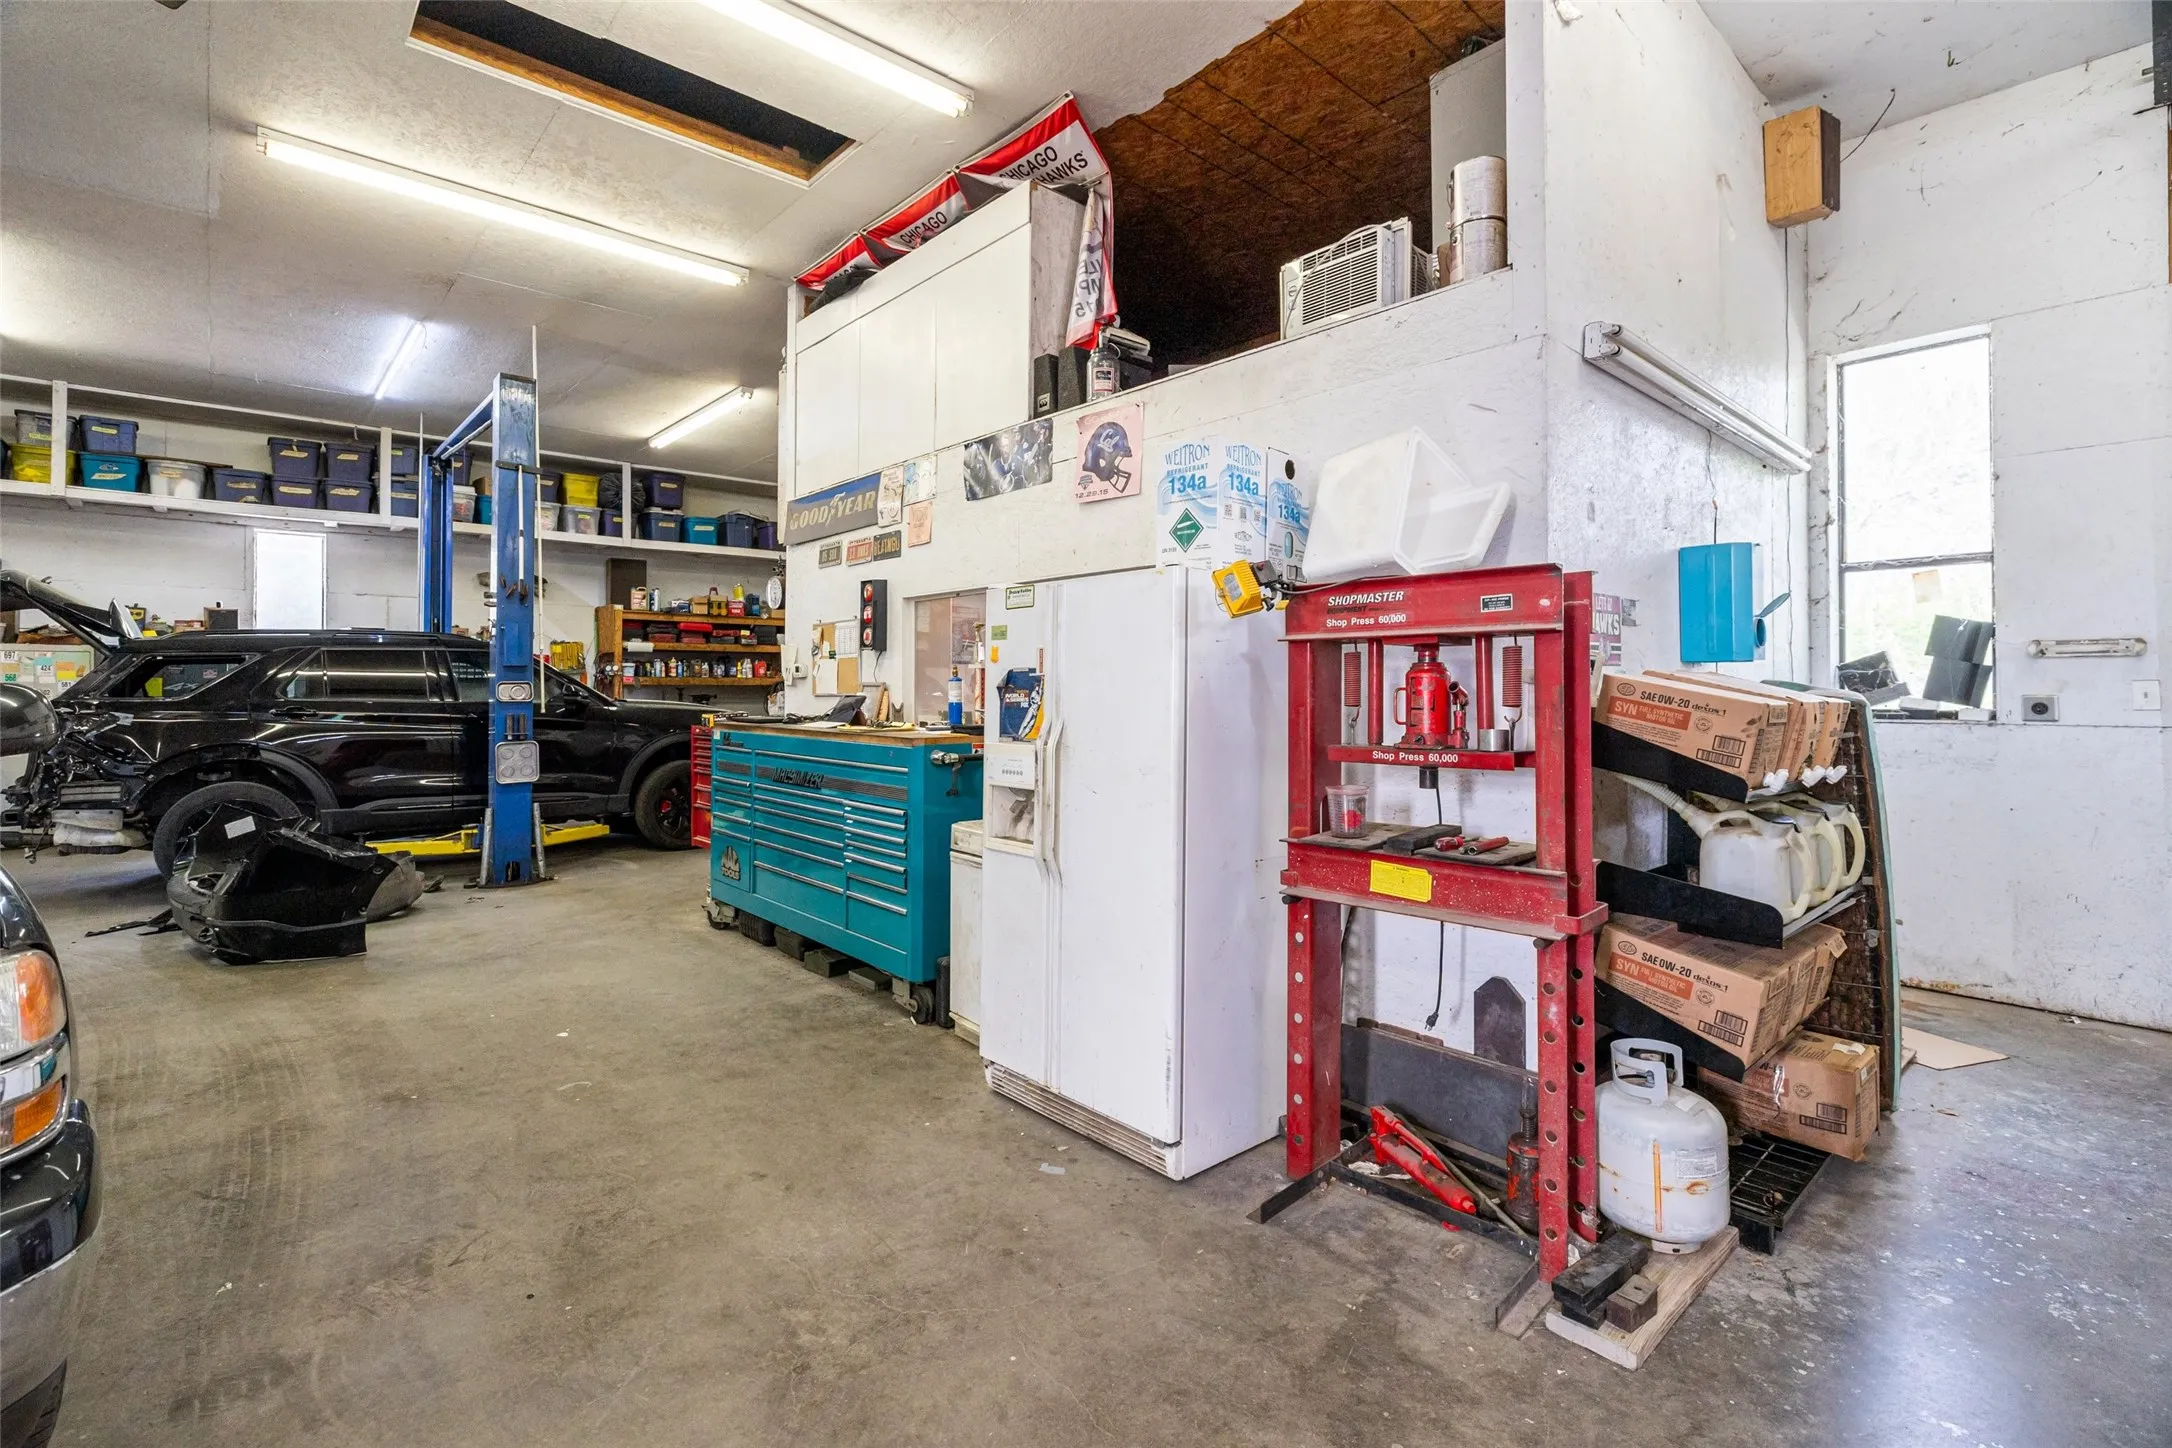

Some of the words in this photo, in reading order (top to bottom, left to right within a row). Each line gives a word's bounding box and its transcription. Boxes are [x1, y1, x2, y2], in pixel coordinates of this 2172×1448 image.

[900, 211, 947, 244] CHICAGO
[1165, 444, 1211, 466] WEITRON
[1225, 444, 1262, 467] WEITRON
[1166, 463, 1209, 476] REFRIGERANT
[1226, 463, 1260, 477] REFRIGERANT
[1168, 473, 1207, 495] 134a
[1228, 472, 1259, 496] 134a
[790, 491, 877, 530] GOODYEAR
[1278, 503, 1300, 523] 134a
[1327, 591, 1404, 606] SHOPMASTER
[1326, 618, 1347, 628] Shop
[1351, 617, 1375, 626] Press
[1378, 613, 1407, 624] 60,000
[4, 651, 16, 659] 697
[1640, 690, 1658, 702] SAE
[1658, 694, 1691, 709] 0W-20
[1614, 700, 1638, 716] SYN
[1638, 705, 1652, 713] FULL
[1652, 708, 1685, 721] SYNTHETIC
[1645, 713, 1667, 723] MOTOR
[1372, 750, 1395, 761] Shop
[1399, 752, 1424, 761] Press
[1428, 753, 1459, 763] 60,000
[1616, 957, 1640, 976] SYN
[1641, 967, 1654, 977] FULL
[1654, 971, 1686, 988] SYNTHETIC
[1641, 952, 1659, 966] SAE
[1659, 960, 1692, 978] 0W-20
[1648, 976, 1669, 990] MOTOR
